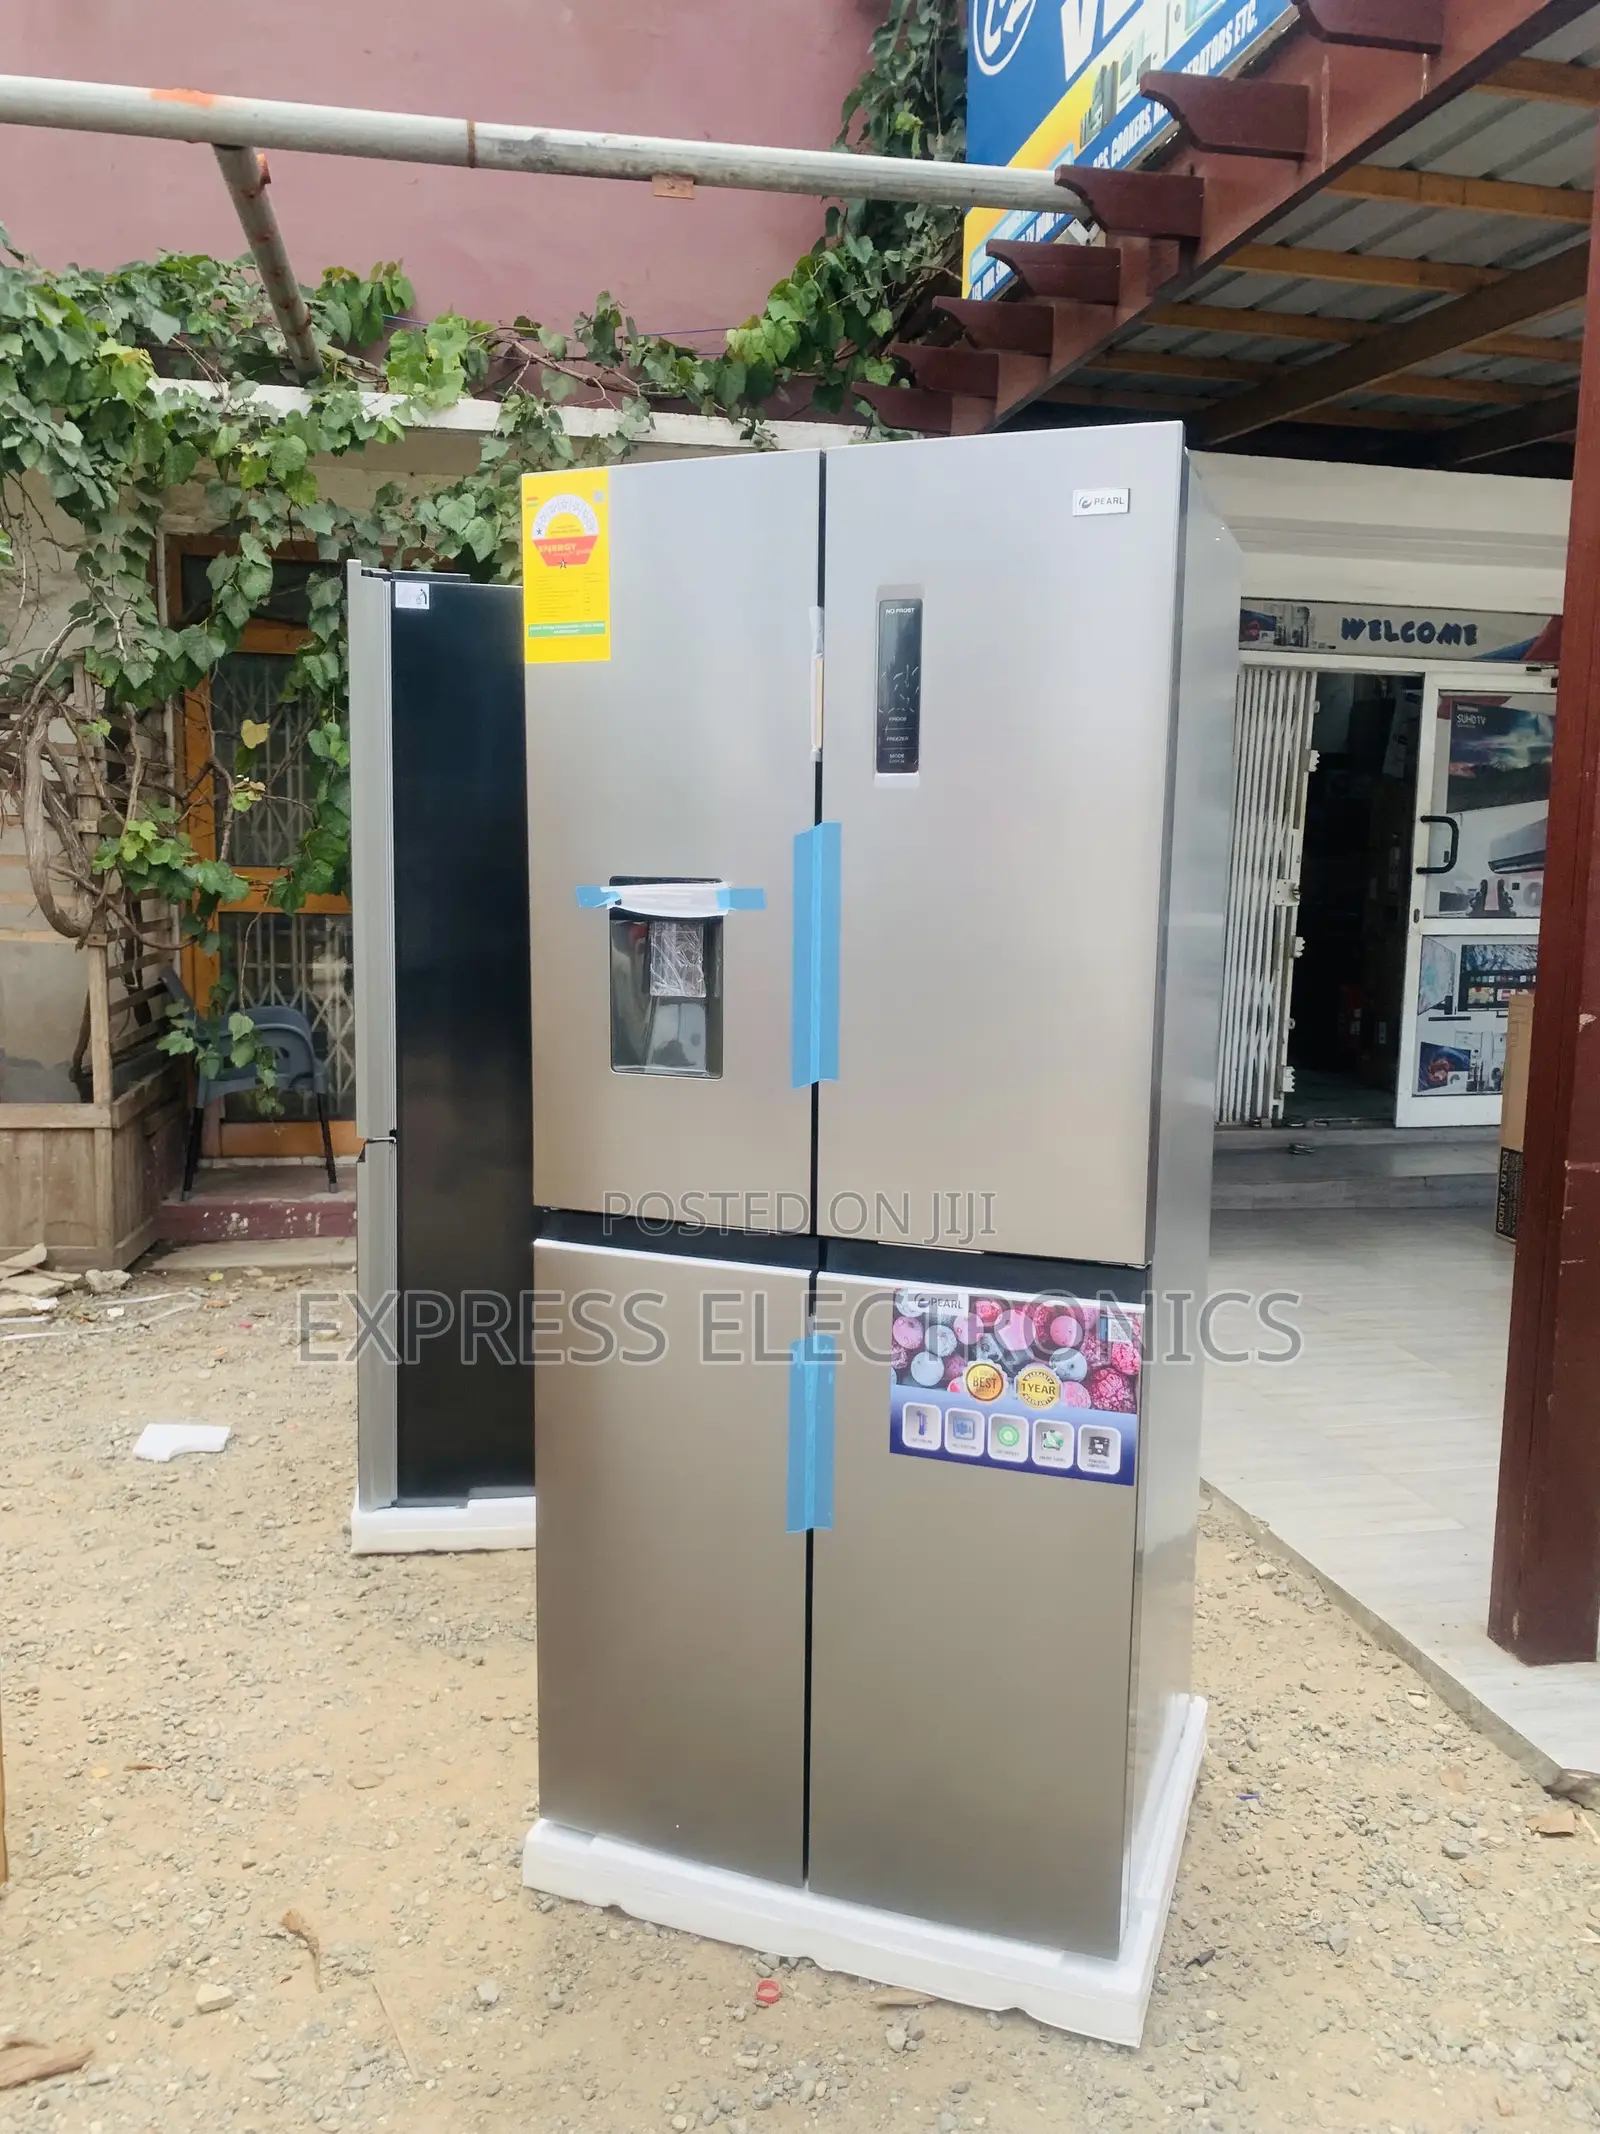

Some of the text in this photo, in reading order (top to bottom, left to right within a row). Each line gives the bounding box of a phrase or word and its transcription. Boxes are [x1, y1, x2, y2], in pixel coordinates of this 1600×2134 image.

[1094, 496, 1125, 506] PEARL
[538, 543, 577, 554] ENERGY
[1341, 617, 1477, 646] WELCOME
[1497, 1151, 1509, 1230] DOLBY AUDIO
[930, 1297, 964, 1310] PEARL
[973, 1376, 997, 1389] BEST
[1027, 1384, 1056, 1396] YEAR
